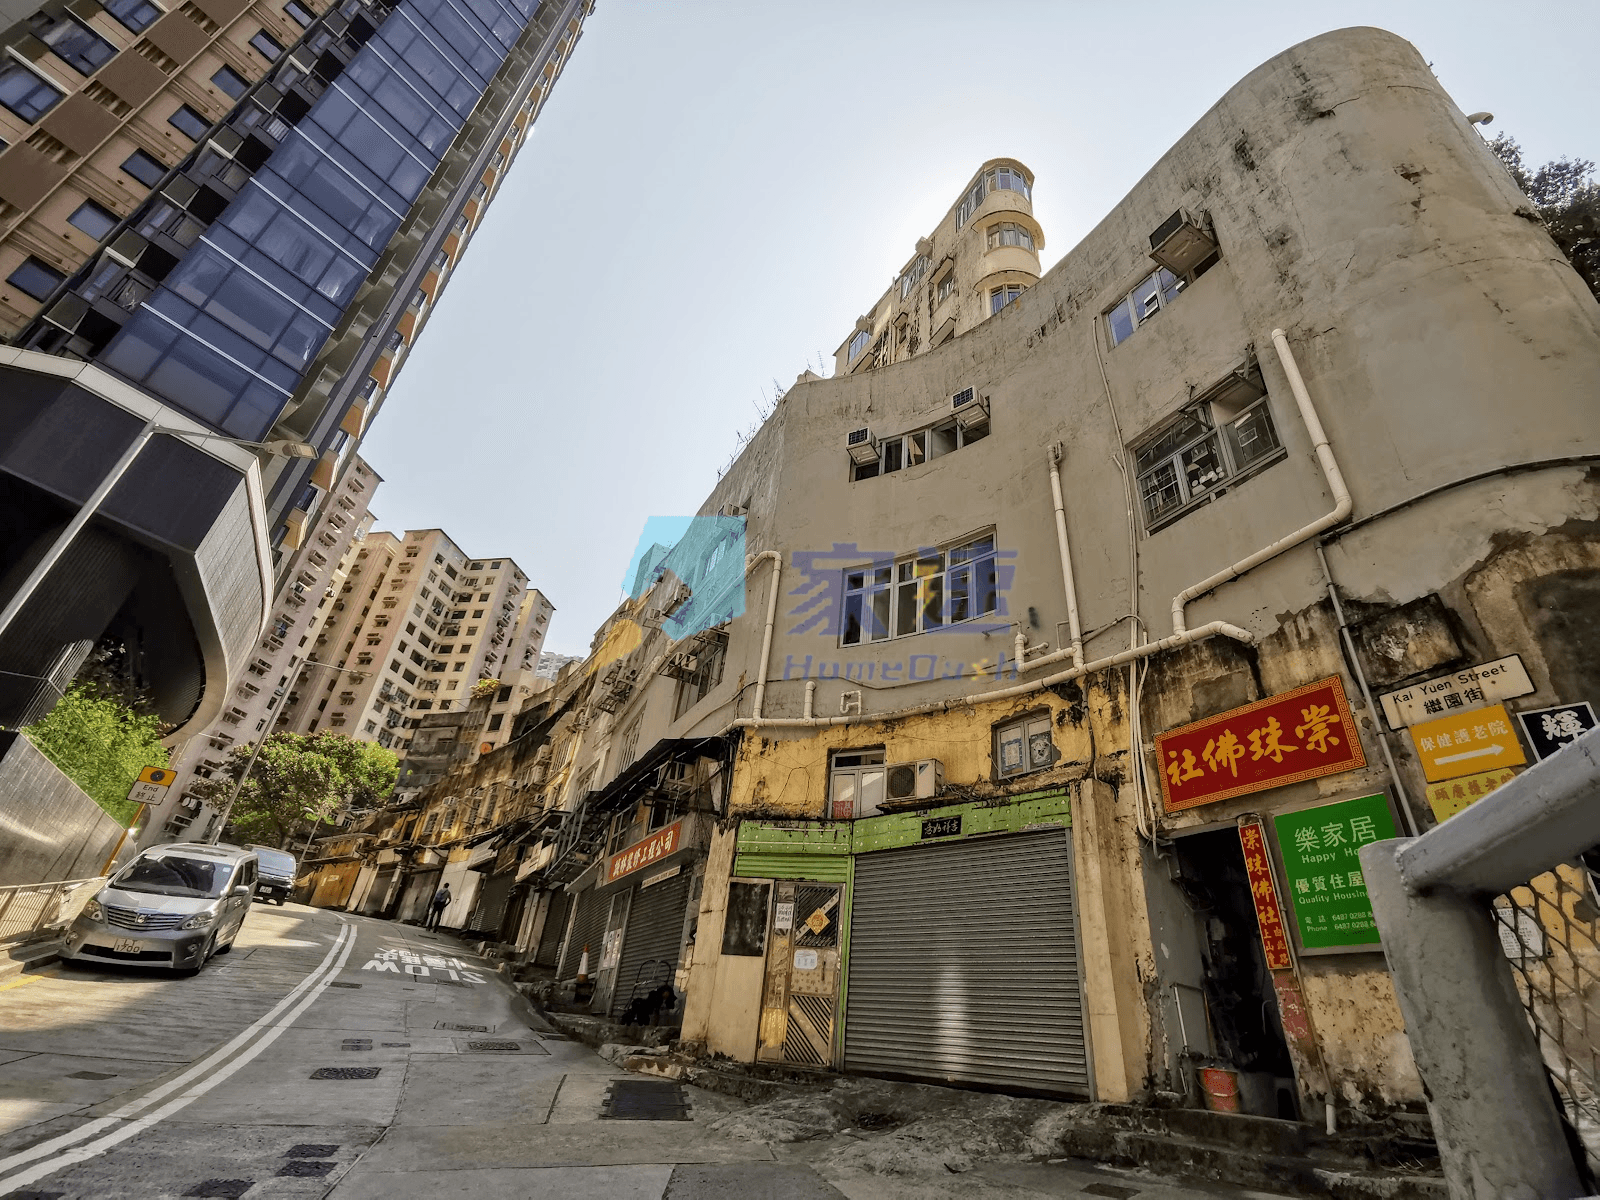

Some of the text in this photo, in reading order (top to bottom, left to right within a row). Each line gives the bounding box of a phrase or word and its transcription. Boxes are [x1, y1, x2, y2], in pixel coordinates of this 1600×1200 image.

[1392, 664, 1508, 704] Kai Yuen Street
[1423, 687, 1486, 715] 繼園街
[1420, 719, 1509, 752] 保健護老院
[135, 791, 155, 801] 終止
[143, 785, 159, 793] End
[1294, 815, 1377, 852] 樂家居
[1301, 852, 1336, 864] Happy
[1295, 870, 1366, 895] 優質住屋
[1298, 894, 1330, 905] Quality
[361, 960, 487, 984] SLOW
